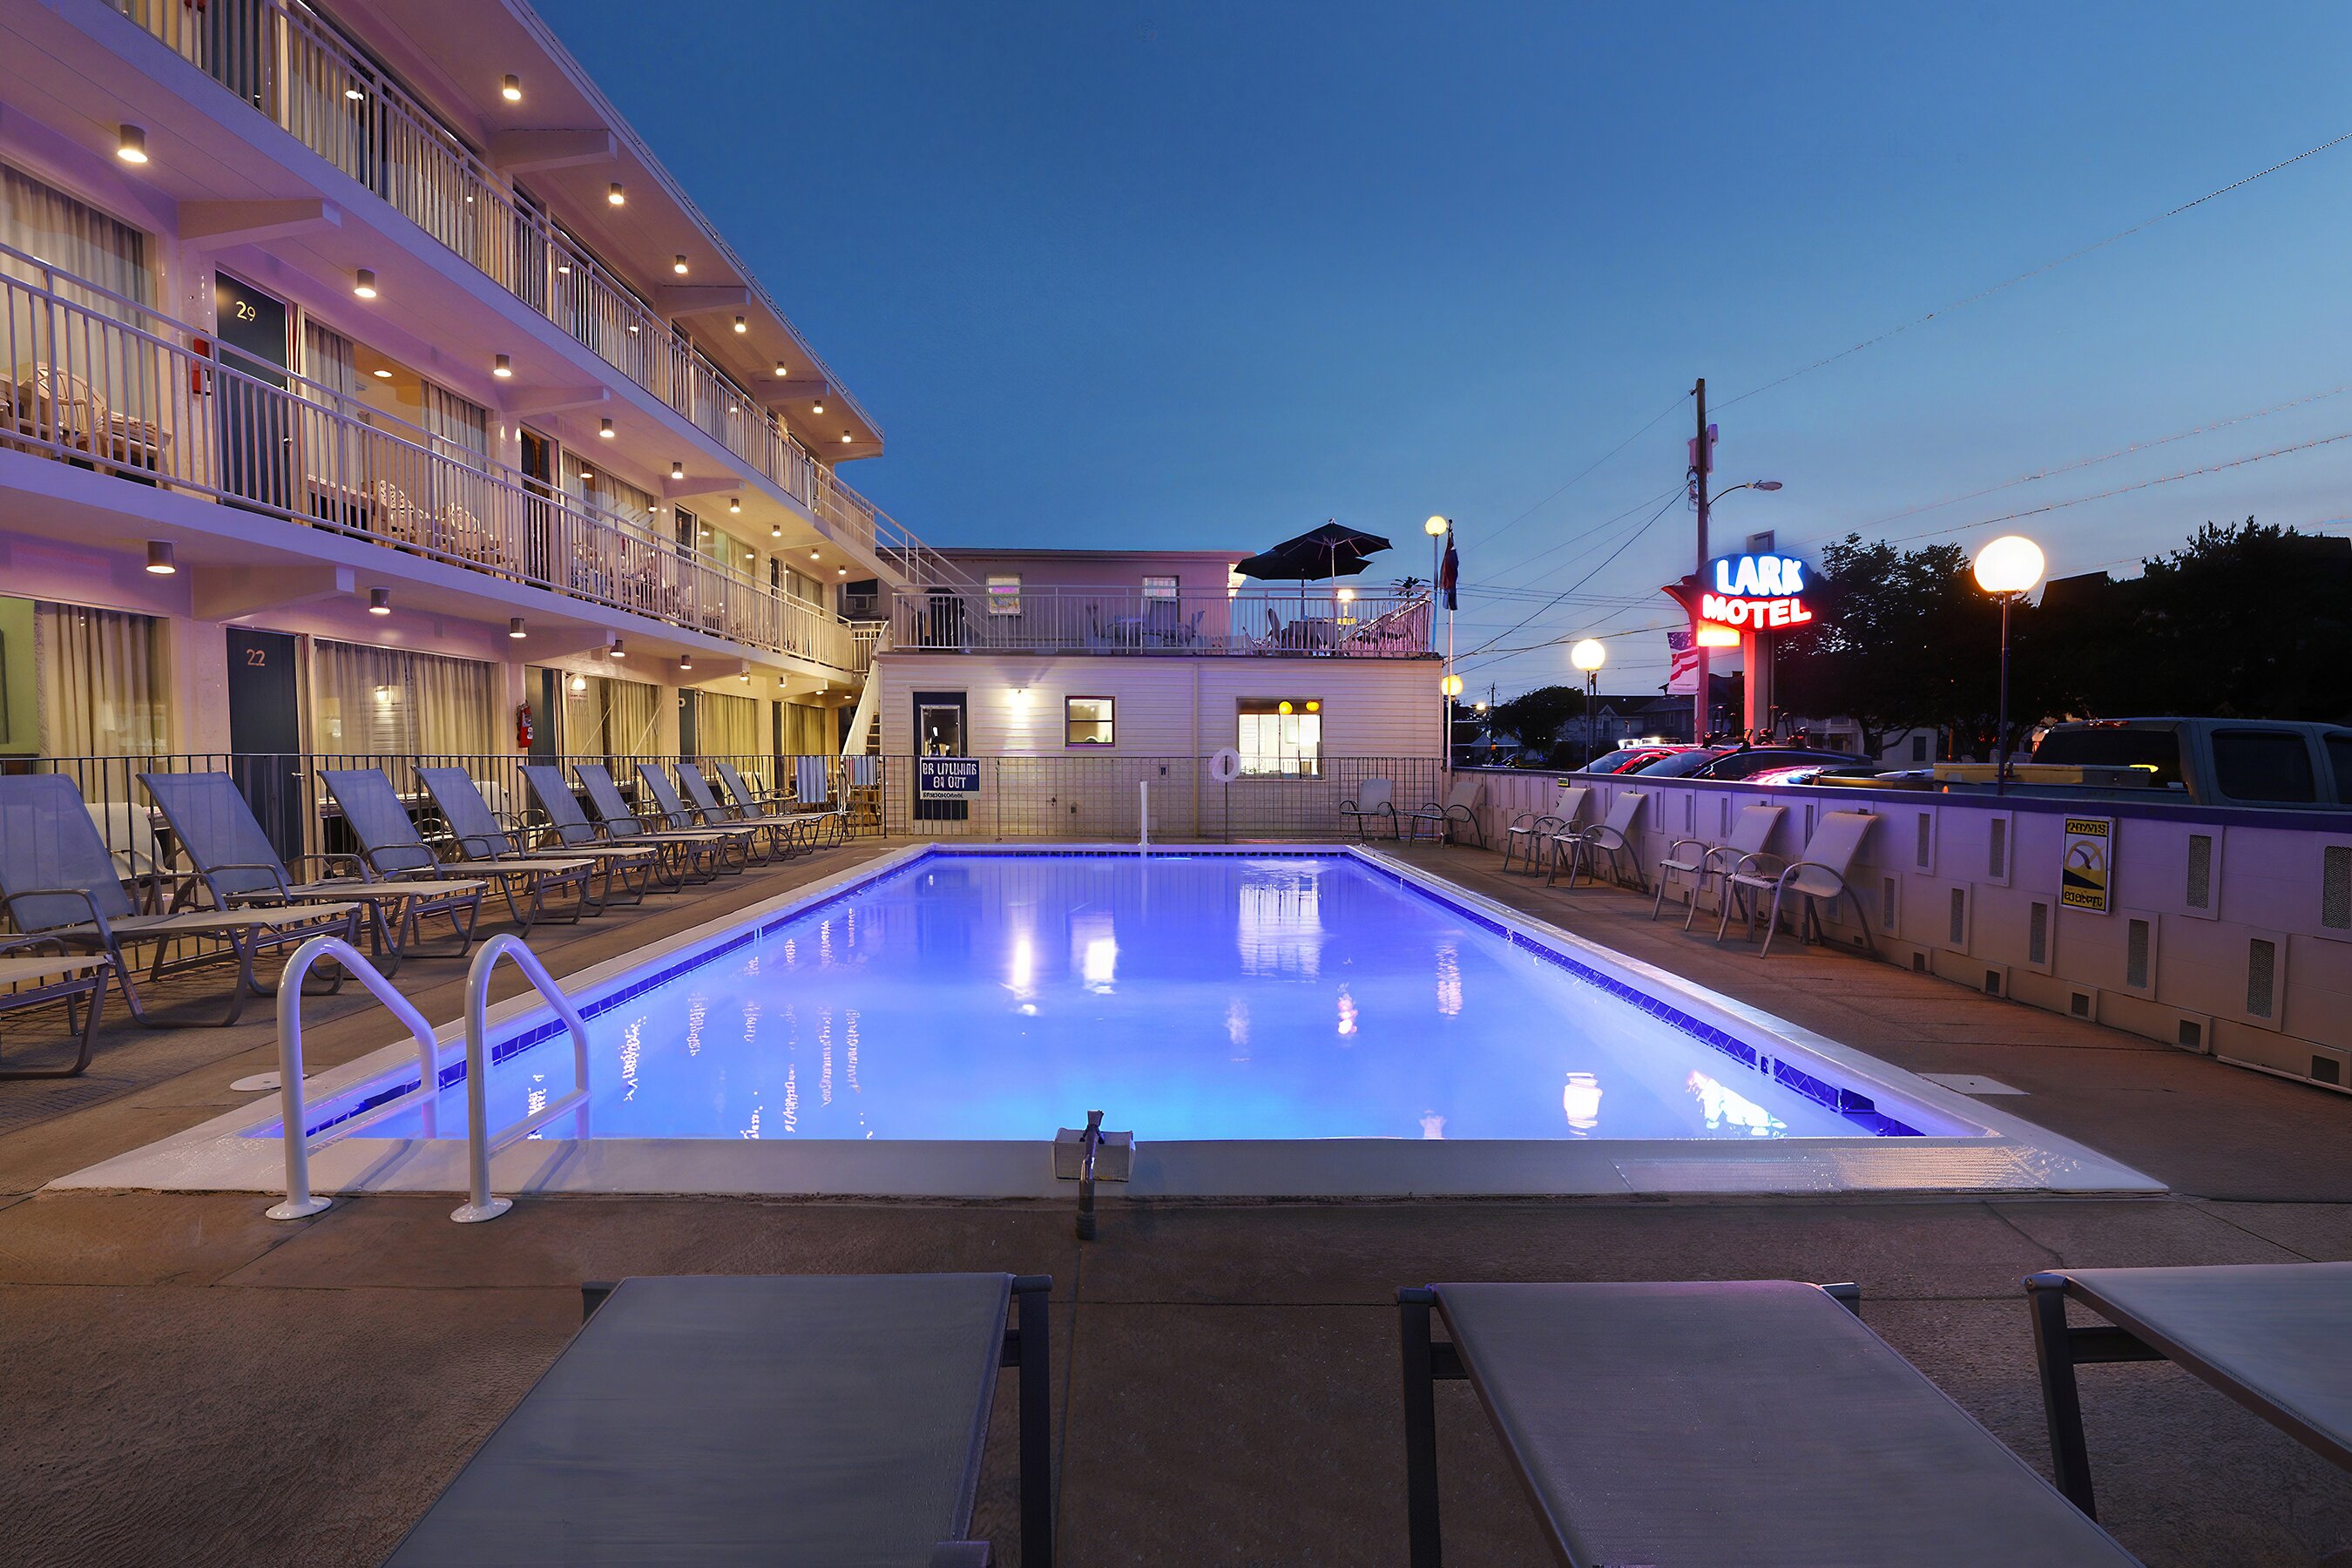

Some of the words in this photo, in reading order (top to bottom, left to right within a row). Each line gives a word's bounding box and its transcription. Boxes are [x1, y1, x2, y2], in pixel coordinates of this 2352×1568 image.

[235, 301, 256, 321] 29
[1716, 556, 1804, 596] LARK
[1702, 594, 1812, 629] MOTEL
[246, 648, 266, 666] 22
